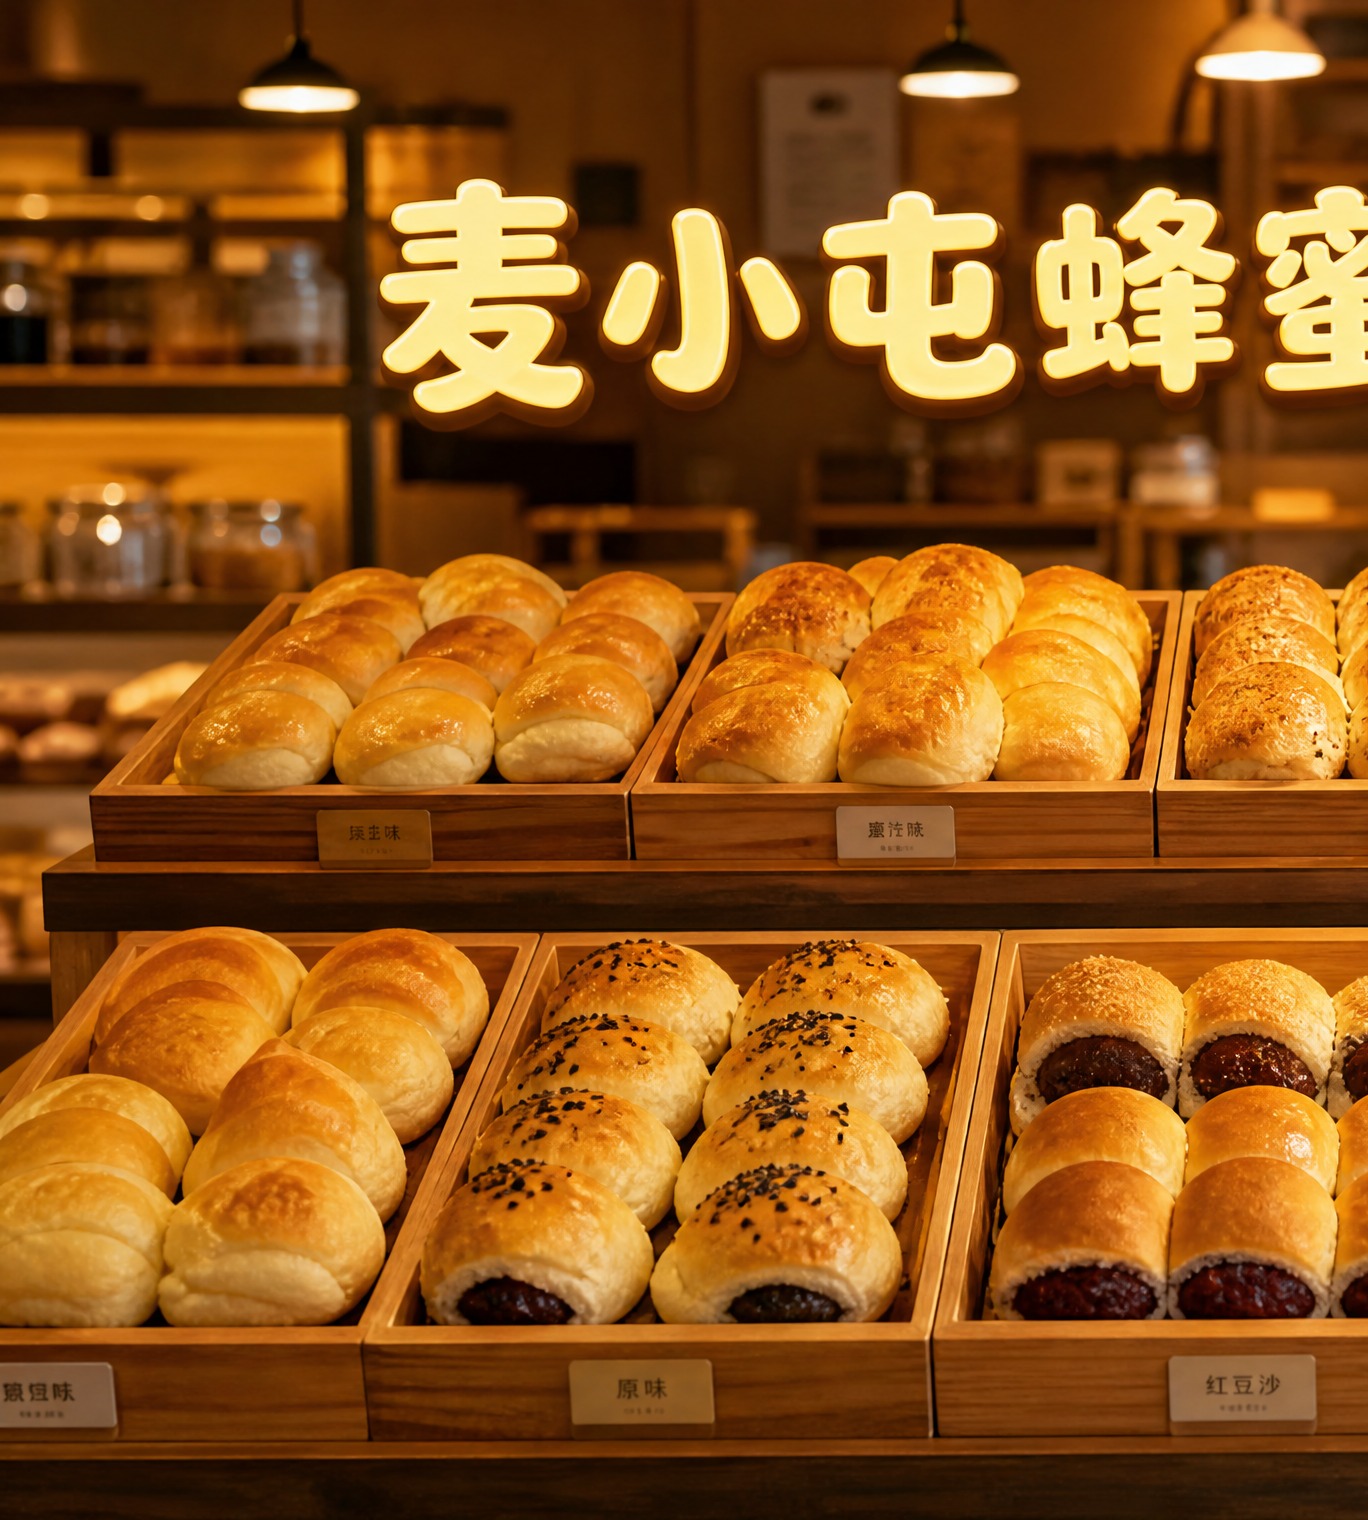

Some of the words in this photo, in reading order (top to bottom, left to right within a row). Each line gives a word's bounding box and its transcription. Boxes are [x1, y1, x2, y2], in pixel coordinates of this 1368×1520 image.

[617, 1377, 667, 1399] 原味
[1206, 1374, 1281, 1396] 红豆沙
